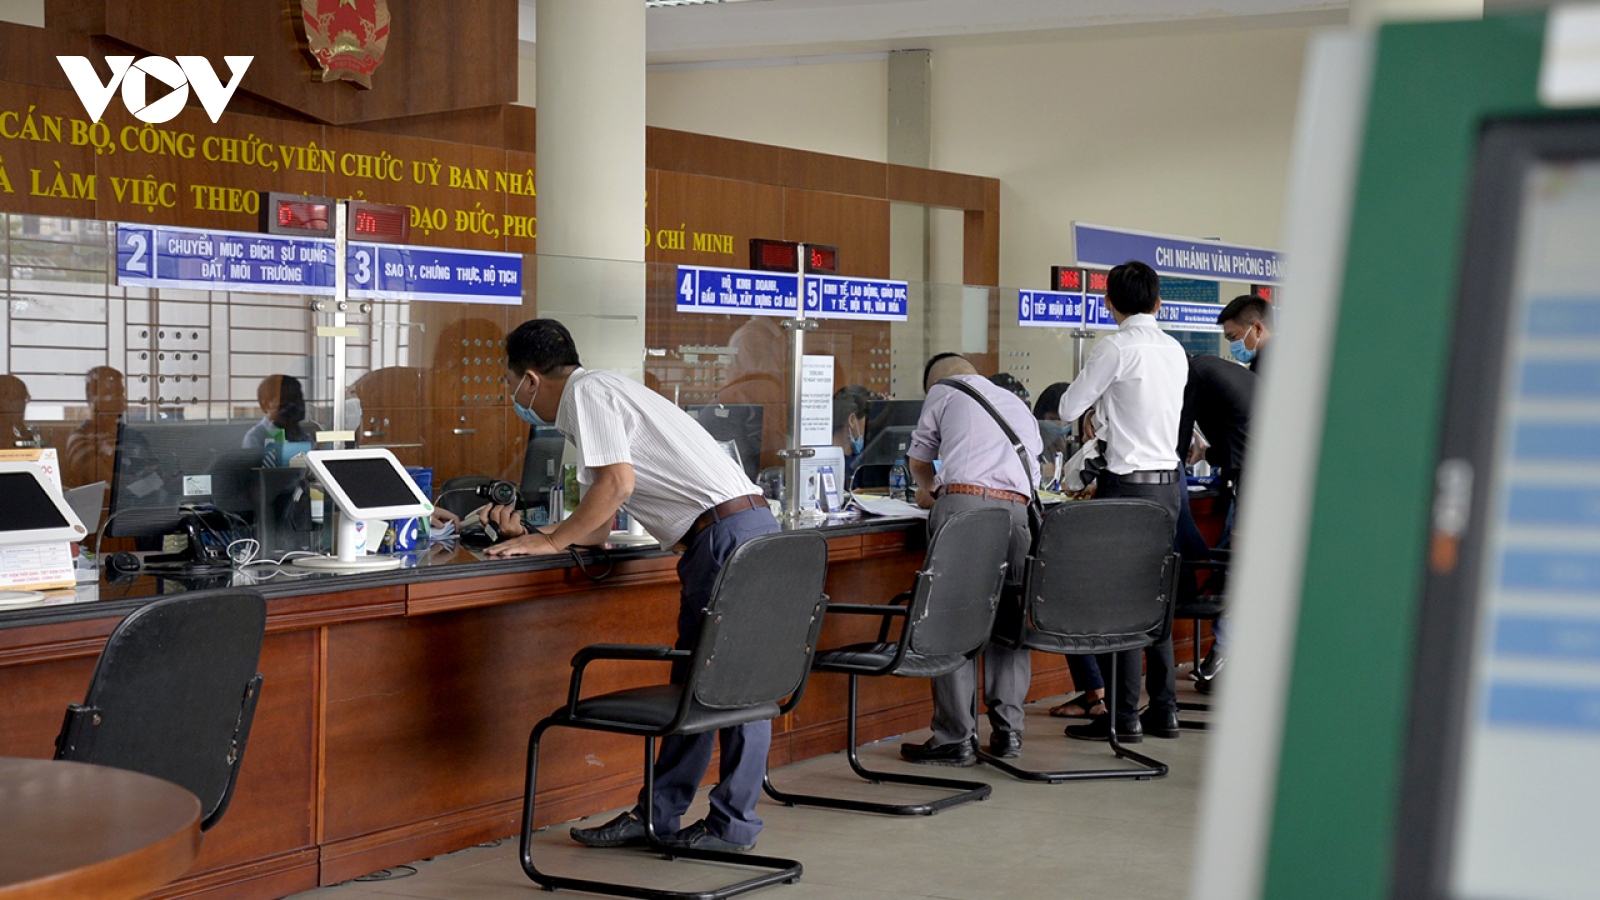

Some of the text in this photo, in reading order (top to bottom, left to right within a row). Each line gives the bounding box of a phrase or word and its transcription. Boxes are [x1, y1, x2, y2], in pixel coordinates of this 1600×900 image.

[0, 105, 63, 143] CÁN
[120, 123, 196, 159] CÔNG
[202, 134, 279, 172] CHỨC,
[279, 141, 336, 174] VIÊN
[340, 151, 403, 182] CHỨC
[412, 157, 441, 186] UỶ
[449, 166, 489, 191] BAN
[495, 169, 537, 196] NHÂ
[30, 160, 97, 201] LÀM
[110, 174, 176, 213] VIỆC
[190, 185, 260, 215] THEO
[407, 205, 448, 235] ĐẠO
[455, 202, 499, 239] ĐỨC,
[126, 234, 147, 271] 2
[168, 234, 327, 266] CHUYỂN MỤC ĐÍCH SỬ DỤNG
[656, 223, 686, 250] CHÍ
[693, 232, 734, 254] MINH
[201, 258, 301, 282] ĐẤT, MÔI TRƯỜNG
[354, 250, 371, 284] 3
[384, 259, 518, 287] SAO Y, CHỨNG THỰC, HỘ TỊCH
[1155, 246, 1174, 267] CHI
[1176, 246, 1210, 272] NHÁNH
[1211, 250, 1231, 274] VĂN
[1232, 252, 1264, 277] PHÒNG
[680, 273, 693, 301] 4
[736, 278, 751, 290] KINH
[807, 281, 818, 308] 5
[1021, 295, 1030, 318] 6
[1088, 299, 1096, 320] 7
